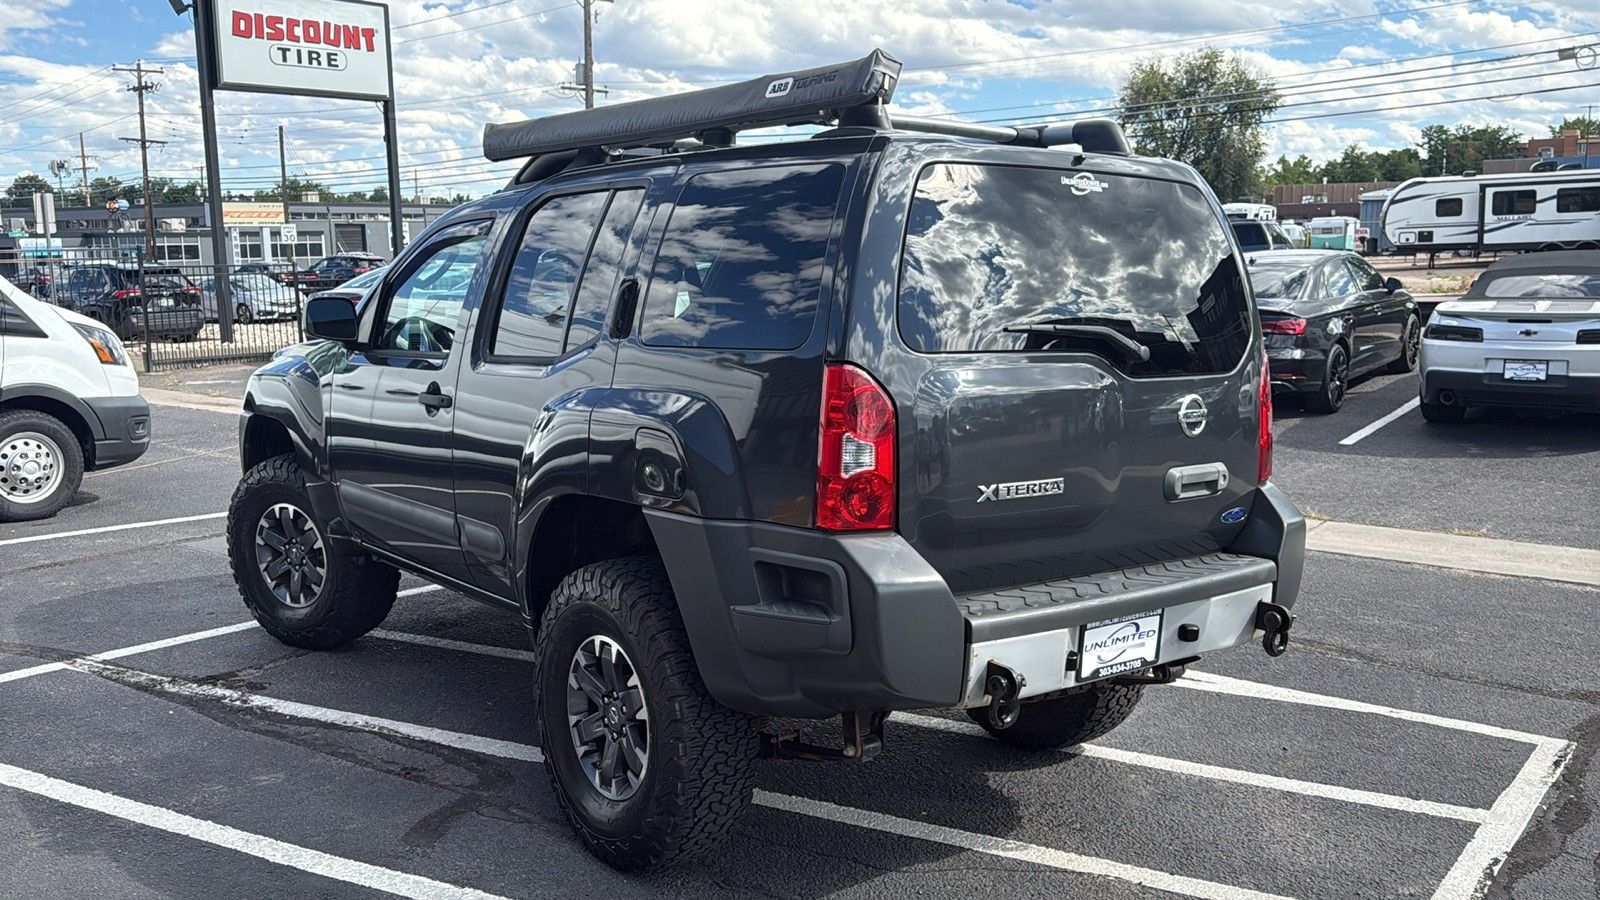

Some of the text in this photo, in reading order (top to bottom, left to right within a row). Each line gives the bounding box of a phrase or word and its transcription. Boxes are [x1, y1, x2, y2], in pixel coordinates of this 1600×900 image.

[232, 10, 376, 52] DISCOUNT
[276, 47, 339, 68] TIRE
[769, 82, 790, 94] ARB
[283, 234, 296, 242] 30
[1084, 629, 1156, 652] UNLIMITED
